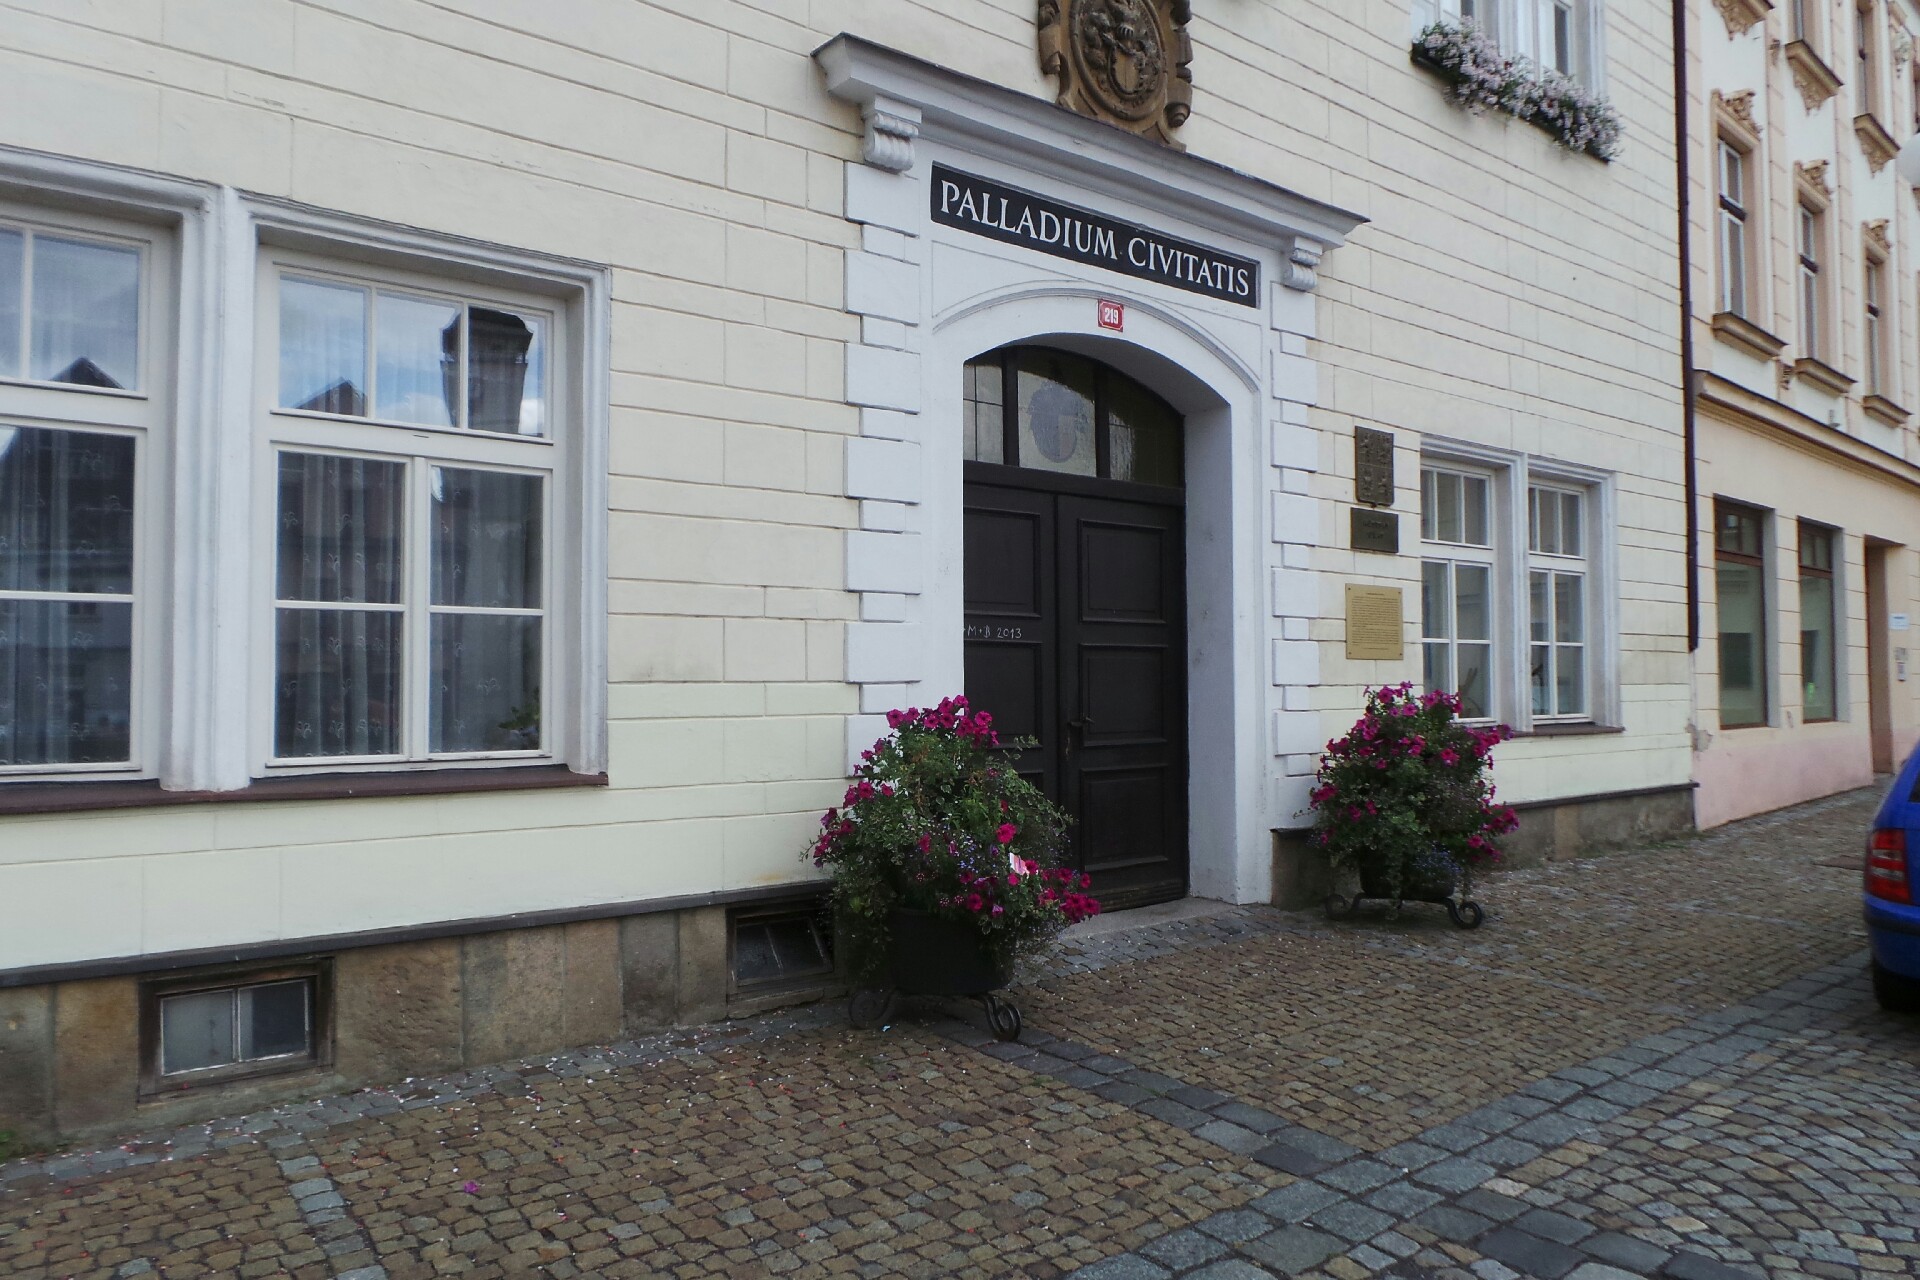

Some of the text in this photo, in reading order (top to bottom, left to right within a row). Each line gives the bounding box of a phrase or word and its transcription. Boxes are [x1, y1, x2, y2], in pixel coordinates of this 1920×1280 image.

[941, 180, 1249, 296] PALLADIUM CIVITATIS
[1104, 307, 1119, 325] 219
[997, 627, 1022, 639] 2013
